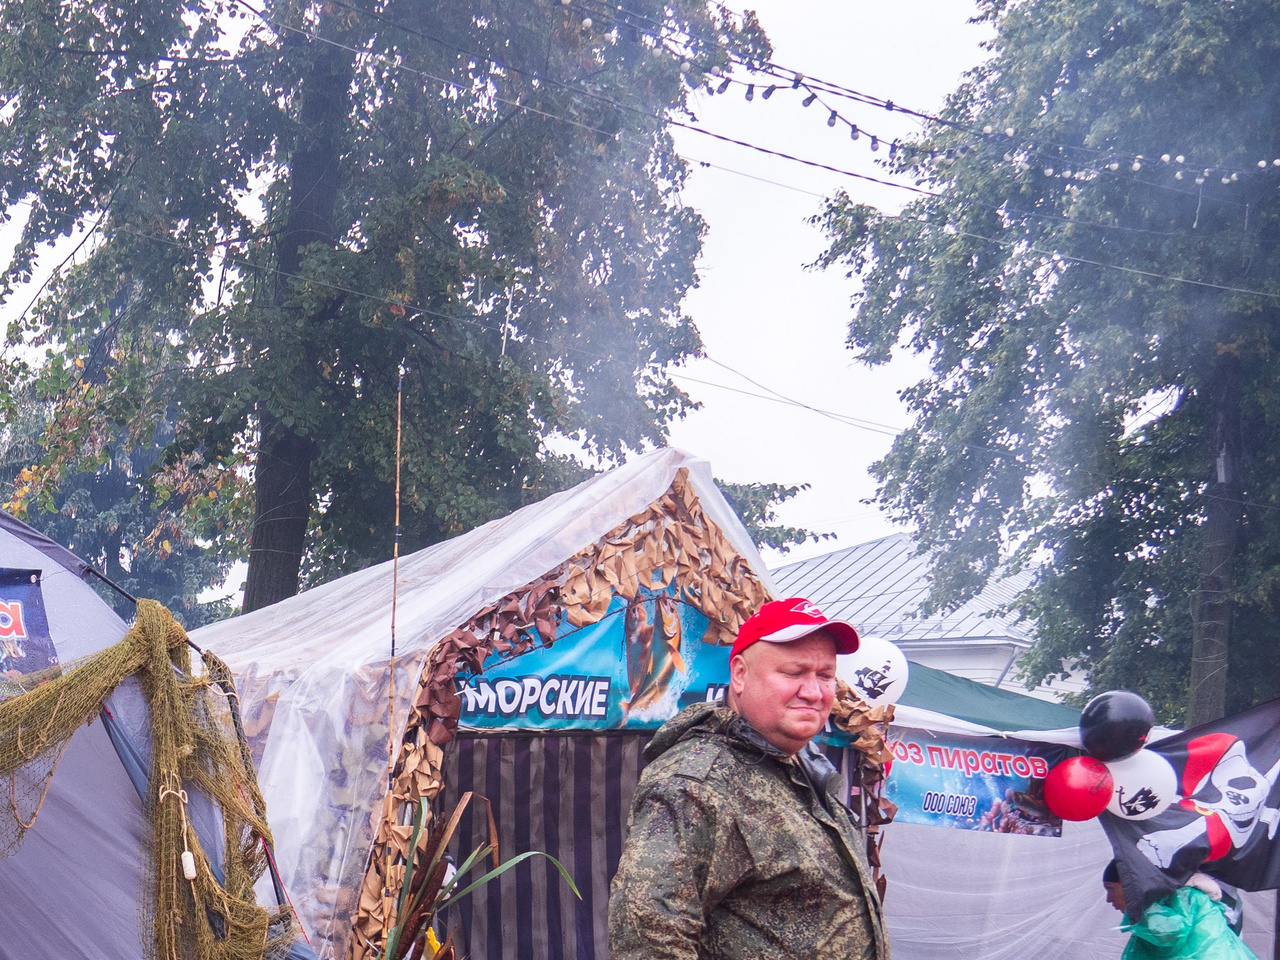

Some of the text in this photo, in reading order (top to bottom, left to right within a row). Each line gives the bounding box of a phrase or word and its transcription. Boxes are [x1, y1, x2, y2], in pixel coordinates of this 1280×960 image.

[458, 677, 610, 717] МОРСКИЕ
[926, 746, 1049, 779] пиратов
[923, 792, 977, 816] ООО СОЮЗ
